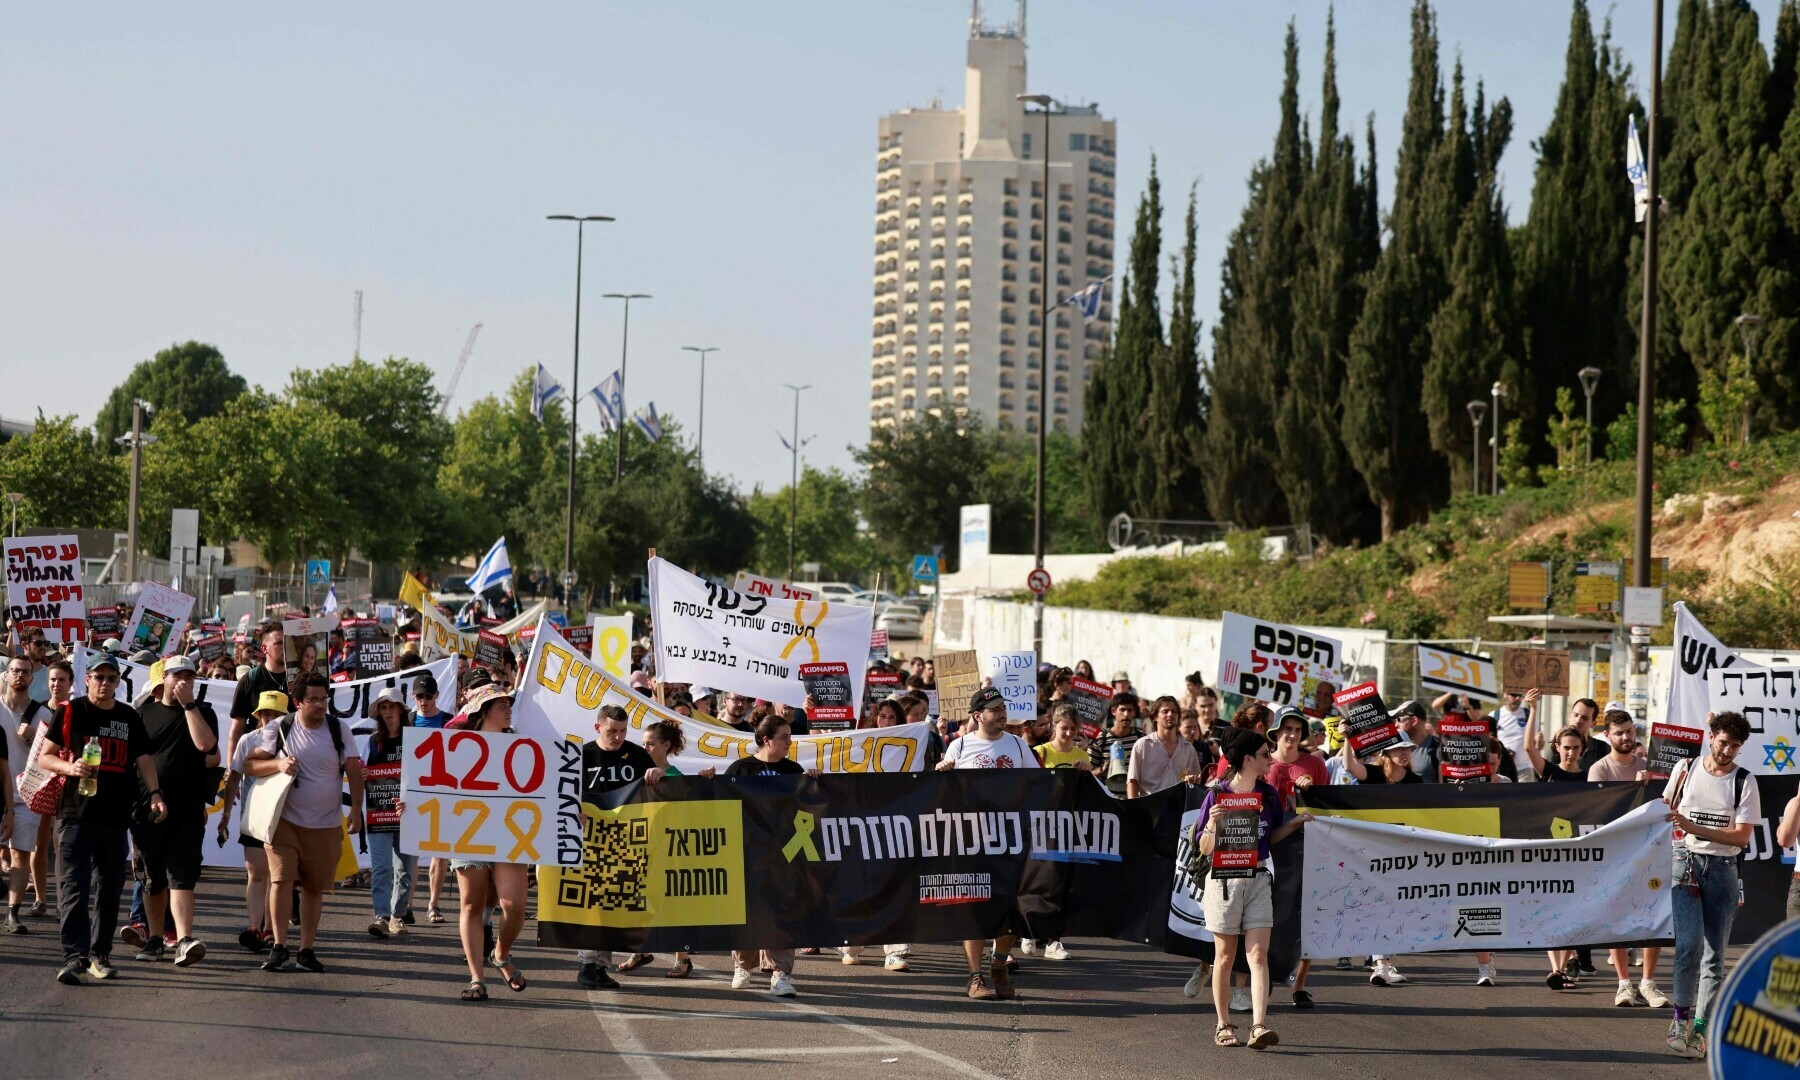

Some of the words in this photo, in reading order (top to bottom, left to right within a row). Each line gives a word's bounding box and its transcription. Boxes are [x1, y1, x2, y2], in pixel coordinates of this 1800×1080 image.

[26, 585, 82, 603] רוצים
[748, 580, 773, 596] את
[11, 603, 61, 621] אותם
[673, 601, 713, 619] בעסקה
[724, 614, 765, 630] שוחררו
[771, 621, 815, 638] חטופים
[480, 632, 503, 643] KIDNAPPED
[521, 629, 537, 637] KIDN
[360, 643, 390, 653] עכשיו.
[665, 645, 687, 658] צבאי
[1254, 624, 1334, 669] הסכם
[360, 652, 381, 661] היום
[691, 649, 737, 667] במבצע
[992, 655, 1033, 673] עסקה
[362, 662, 393, 671] שאחרי
[746, 660, 789, 678] שוחררו
[804, 665, 845, 673] KIDNAPPED
[1251, 649, 1304, 683] יציל
[1428, 651, 1482, 687] 251
[944, 667, 978, 688] 120
[1720, 669, 1800, 698] חרת
[1074, 680, 1110, 696] KIDNAPPED
[1239, 672, 1292, 705] חיים
[1336, 686, 1374, 703] KIDNAPPED
[1008, 702, 1033, 712] המוח
[1742, 706, 1800, 736] יים
[1654, 726, 1700, 741] KIDNAPPED
[414, 731, 546, 793] 120
[1664, 753, 1685, 762] אמרת
[369, 768, 402, 776] KIDNAPP
[587, 765, 635, 789] 7.10
[1221, 798, 1258, 807] KIDNAPPED
[820, 815, 915, 862] חוזרים
[919, 808, 1023, 857] כשכולם
[1029, 810, 1121, 856] מנצחים
[665, 827, 727, 857] ישראל
[1424, 851, 1446, 868] על
[1452, 849, 1515, 866] חותמים
[1522, 847, 1604, 862] סטודנטים
[1370, 854, 1419, 874] עסקה
[665, 867, 728, 897] חותמת
[920, 874, 943, 886] להחזרת
[943, 873, 975, 885] המשפחות
[976, 873, 991, 884] מטה
[1508, 879, 1575, 895] מחזירים
[920, 886, 954, 901] והנעדרים
[956, 885, 992, 899] החטופים
[1398, 883, 1451, 900] הביתה
[1457, 880, 1501, 897] אותם
